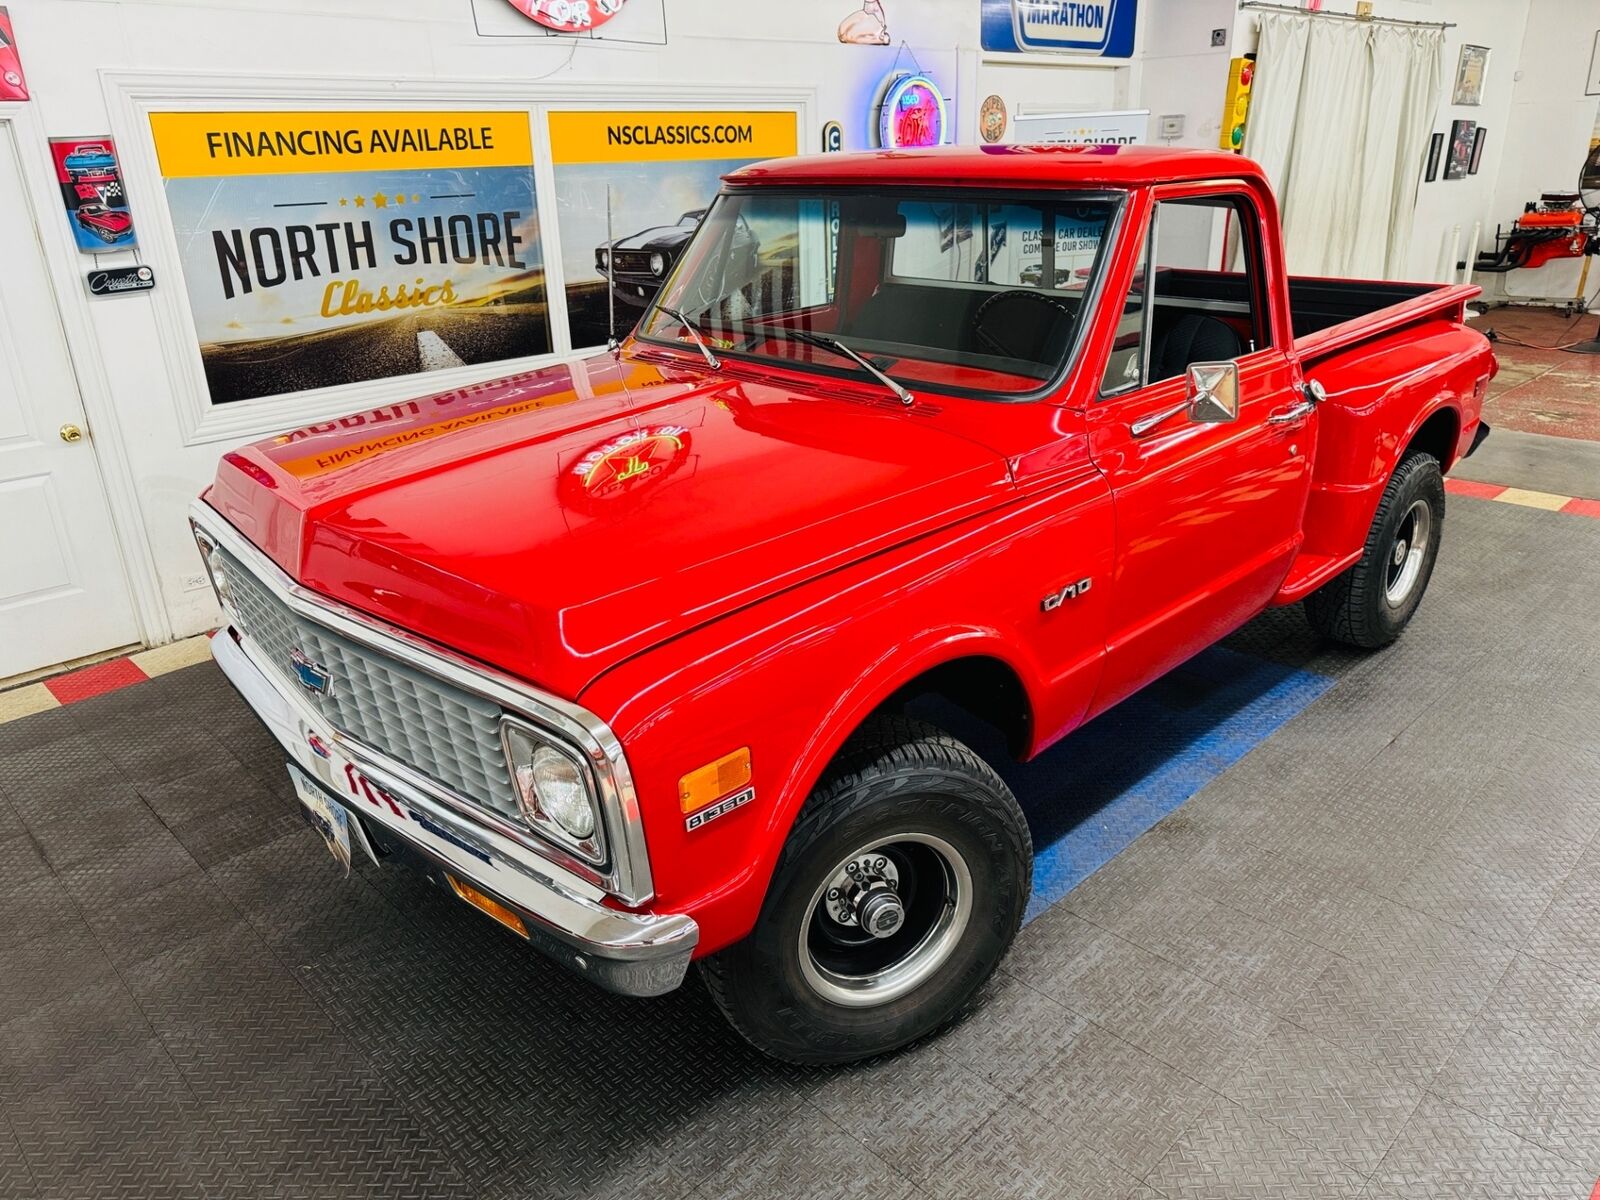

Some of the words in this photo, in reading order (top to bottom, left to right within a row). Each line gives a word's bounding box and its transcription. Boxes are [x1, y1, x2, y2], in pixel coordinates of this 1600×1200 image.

[1027, 1, 1103, 28] MARATHON
[206, 129, 363, 158] FINANCING
[369, 127, 494, 153] AVAILABLE
[607, 125, 752, 145] NSCLASSICS.COM
[1058, 228, 1075, 239] CAR
[212, 221, 377, 300] NORTH
[389, 211, 526, 270] SHORE
[1062, 241, 1077, 252] OUR
[90, 272, 139, 292] Corvette
[320, 278, 458, 318] Classics
